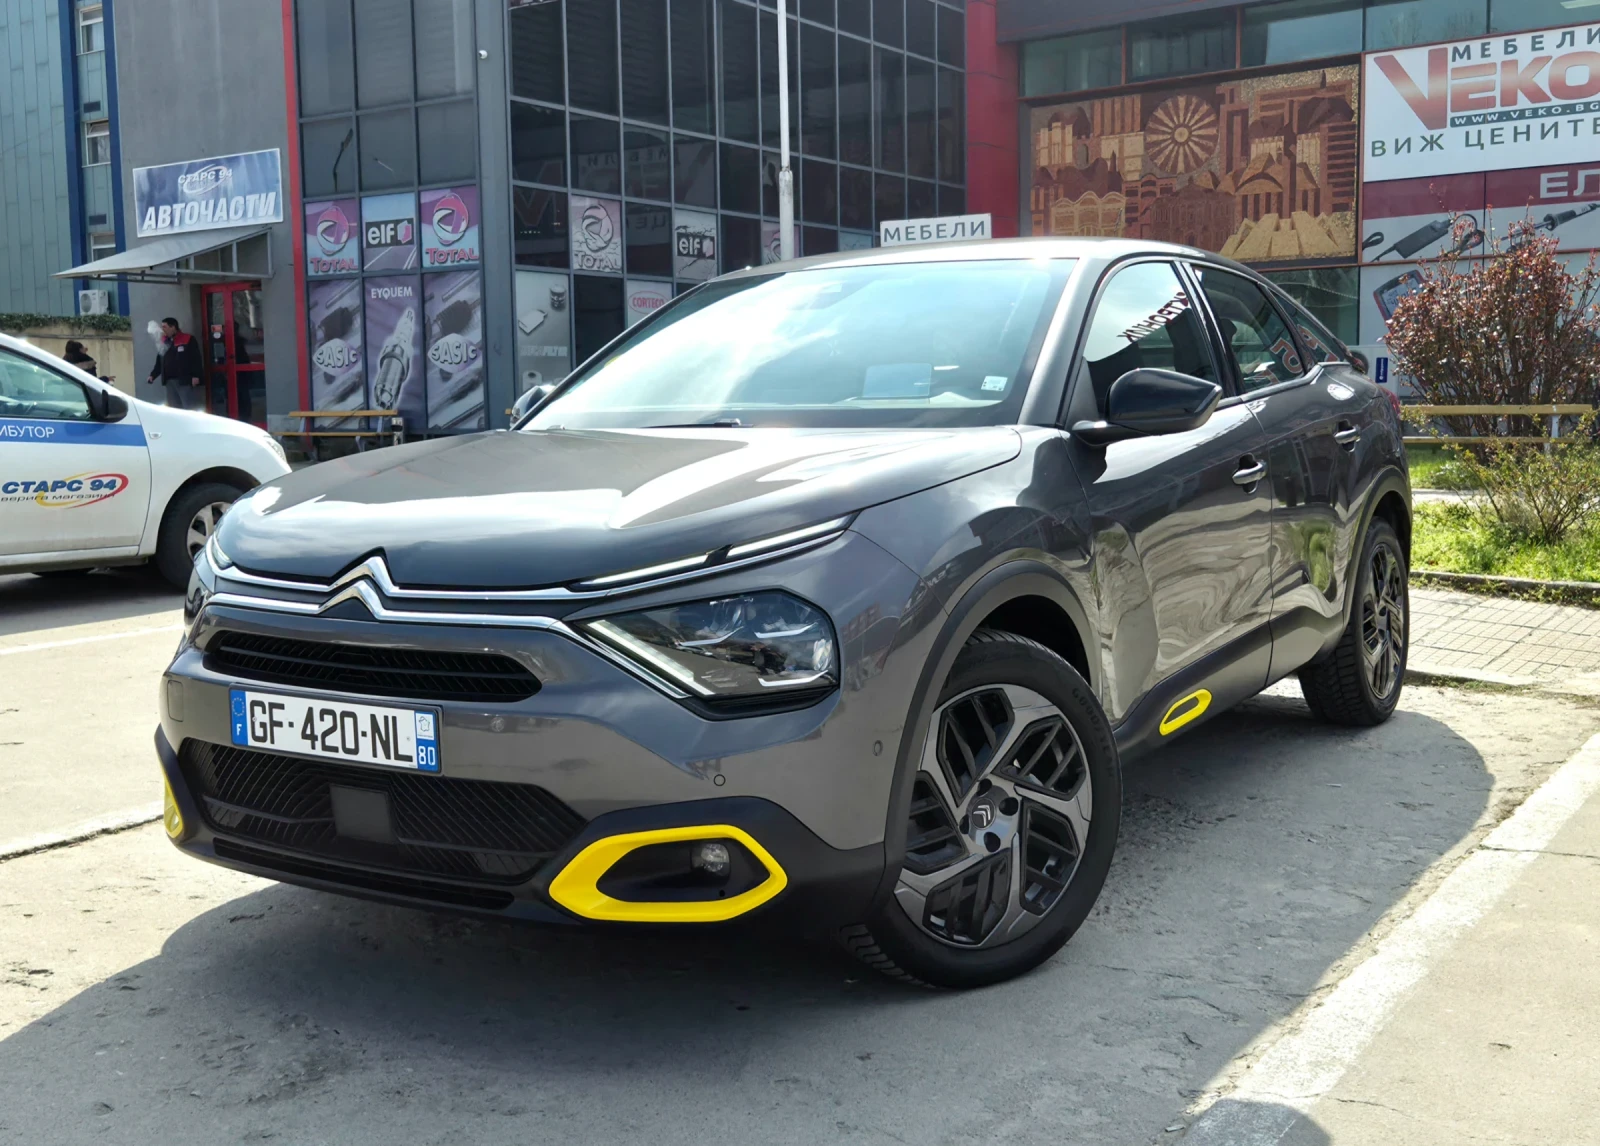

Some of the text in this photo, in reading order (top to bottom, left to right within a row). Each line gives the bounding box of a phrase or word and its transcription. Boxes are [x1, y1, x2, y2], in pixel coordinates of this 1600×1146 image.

[1451, 27, 1600, 63] МЕБЕЛИ
[1374, 47, 1600, 131] VEKO
[1454, 102, 1599, 126] WWW.VEKO.BG
[1371, 117, 1600, 157] ВИЖ ЦЕНИТЕ
[178, 169, 233, 184] СТАРС 94
[141, 192, 277, 231] АВТОЧАСТИ
[367, 223, 396, 245] elf
[883, 220, 986, 242] МЕБЕЛИ
[425, 247, 479, 265] TOTAL
[678, 238, 701, 255] elf
[310, 257, 359, 274] TOTAL
[574, 251, 621, 271] TOTAL
[371, 286, 413, 300] EYQUEM
[632, 297, 665, 309] CORTECO
[0, 425, 55, 438] ИБУТОР
[2, 479, 117, 494] СТАРС 94
[236, 723, 243, 736] F
[249, 699, 414, 763] GF-420-NL
[418, 745, 436, 766] 80
